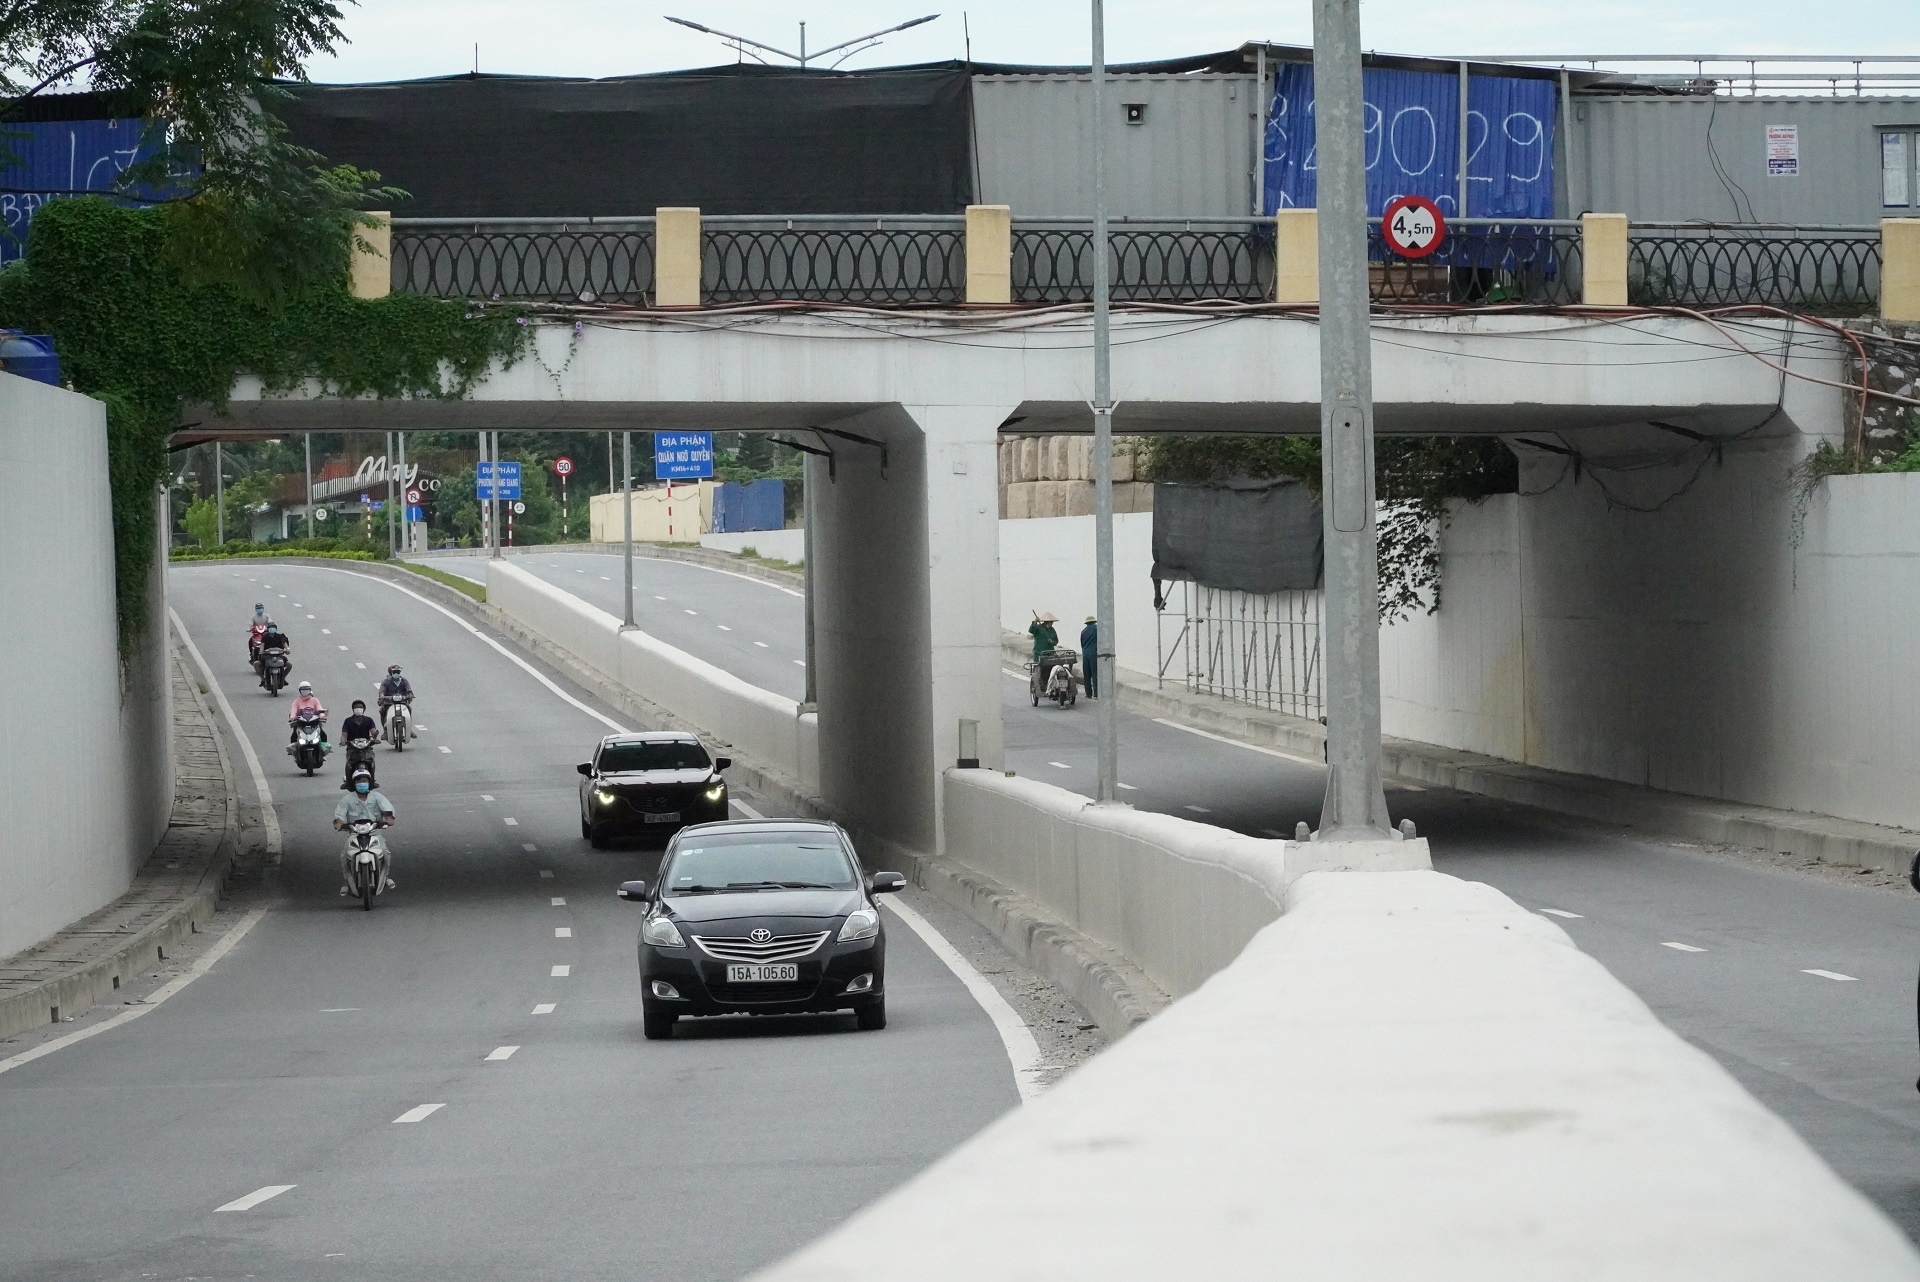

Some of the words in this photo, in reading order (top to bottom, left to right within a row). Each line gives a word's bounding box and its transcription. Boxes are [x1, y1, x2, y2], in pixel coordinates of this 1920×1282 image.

[1393, 215, 1433, 237] 4,5m
[661, 437, 677, 448] ĐỊA
[680, 434, 706, 447] PHẬN
[658, 450, 675, 465] QUẬN
[690, 446, 711, 462] QUYỀN
[354, 456, 418, 489] May
[558, 462, 570, 471] 50
[731, 966, 795, 980] 15A-105.60
